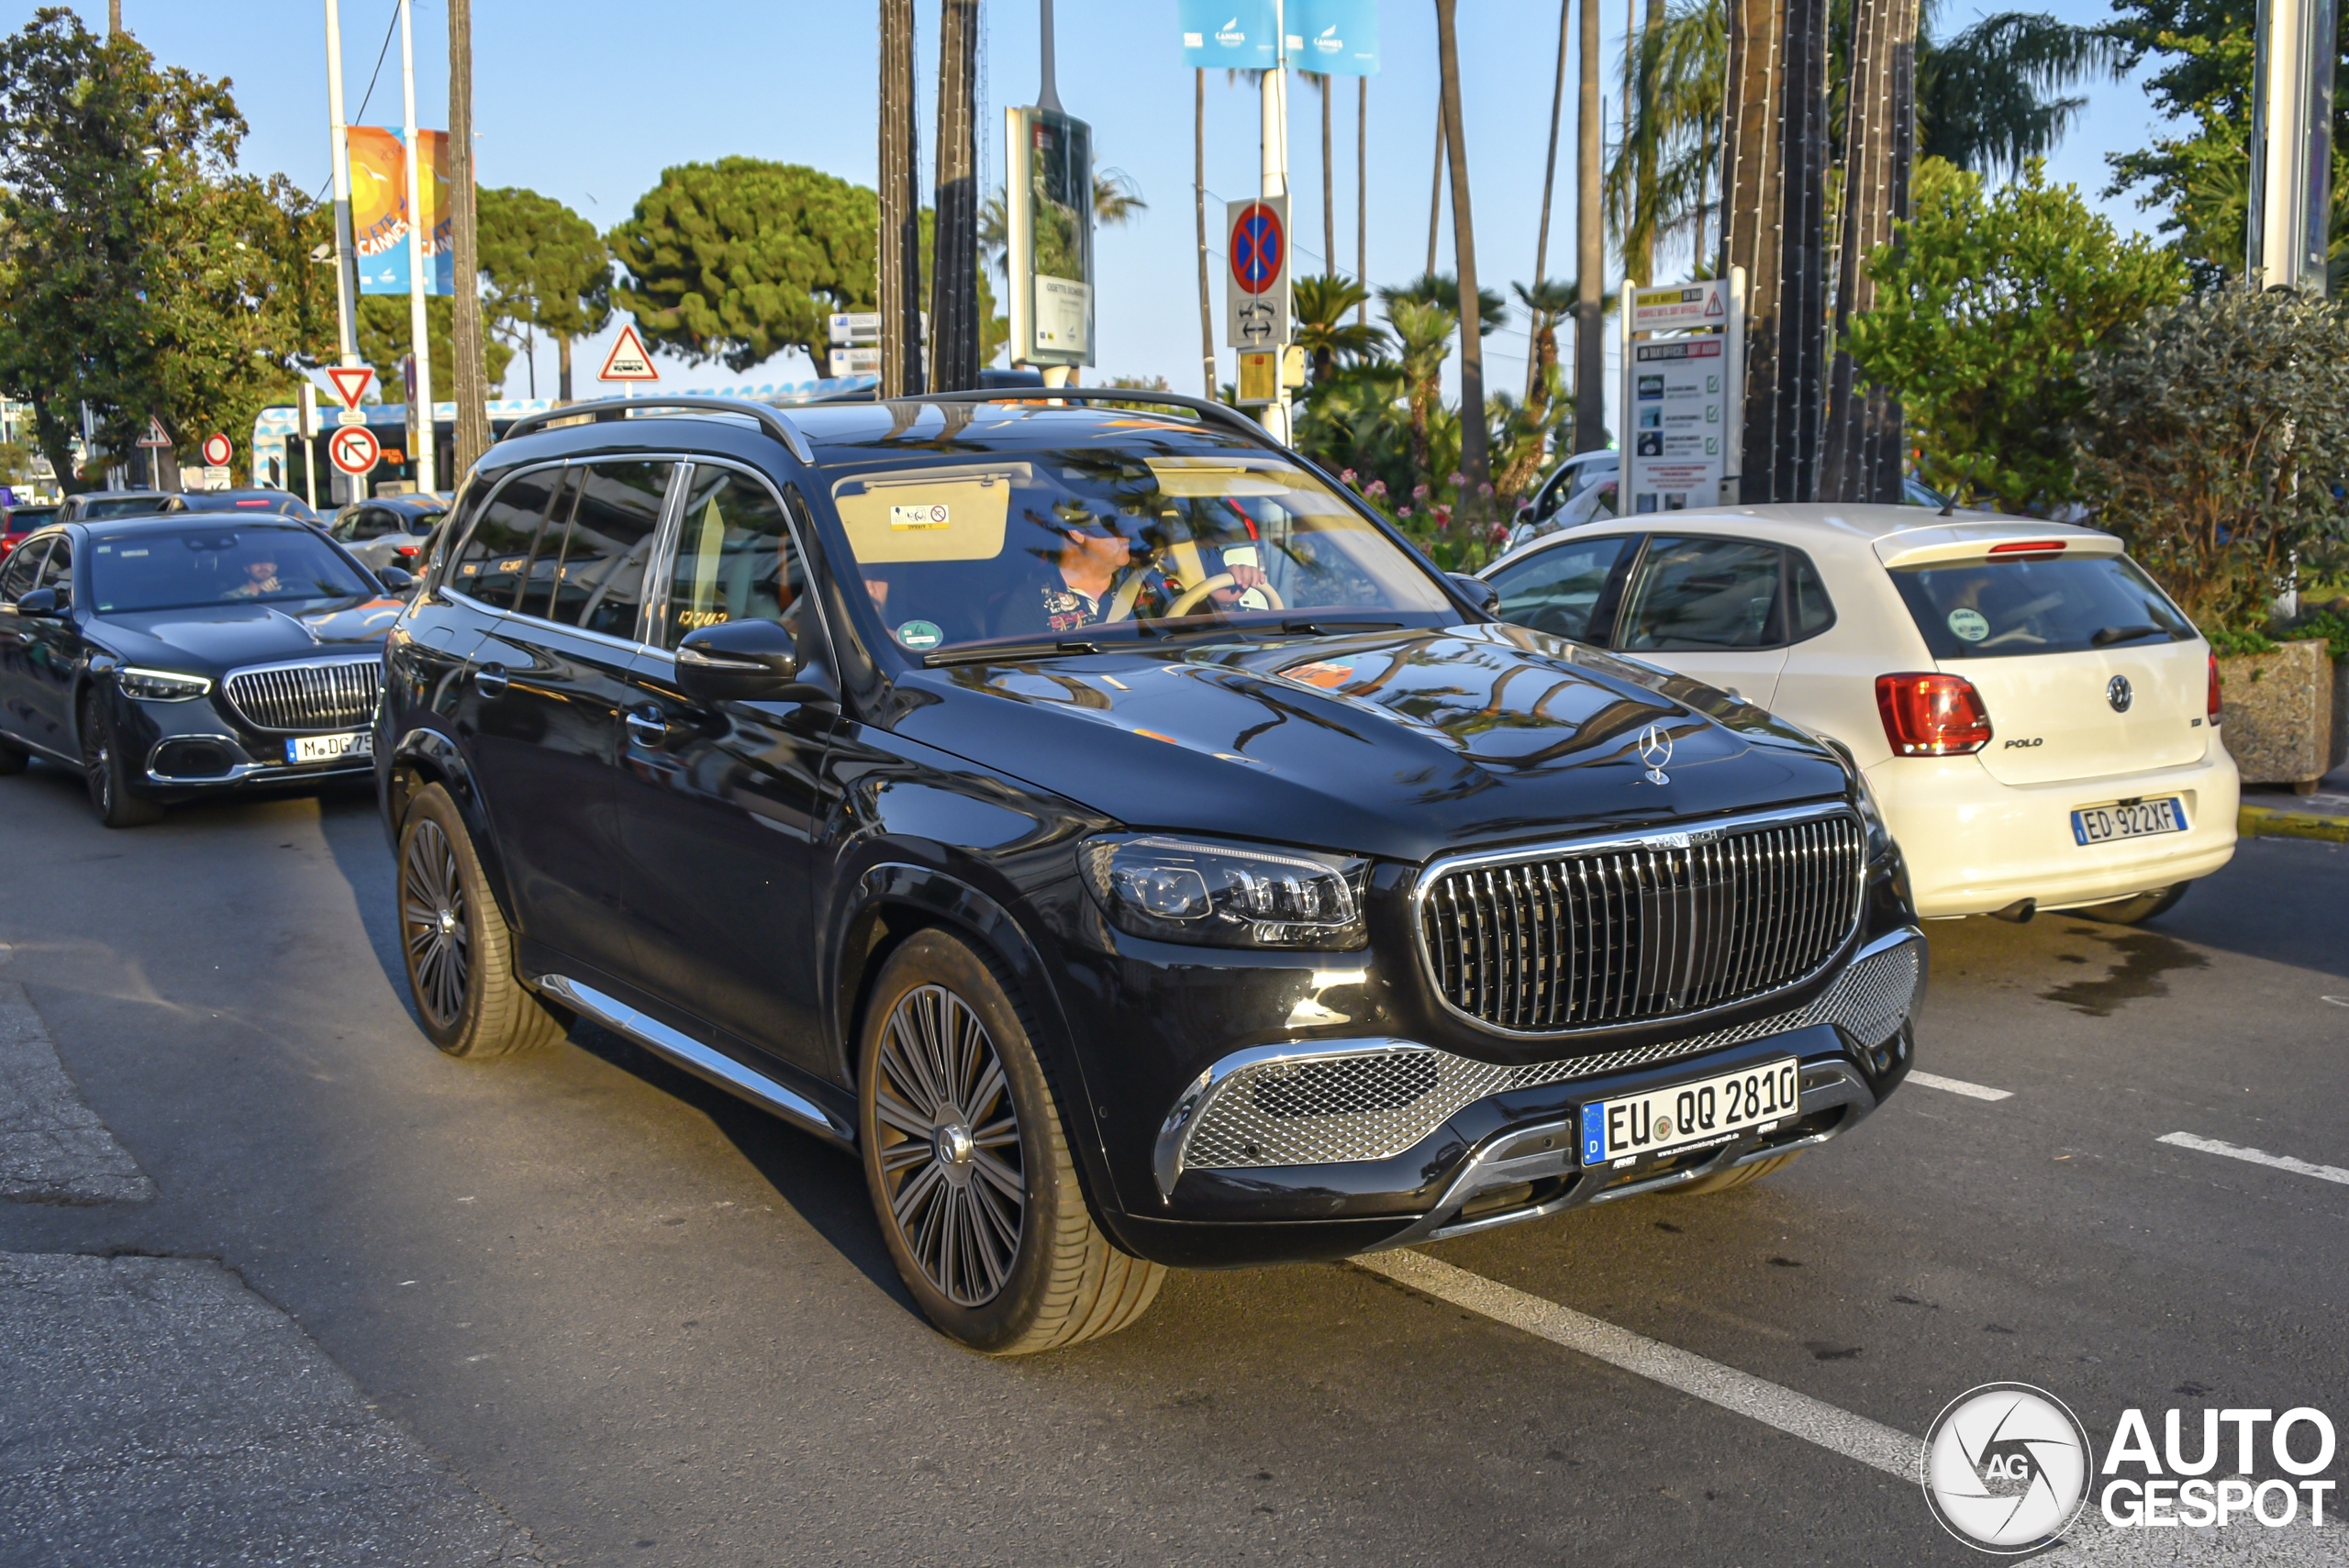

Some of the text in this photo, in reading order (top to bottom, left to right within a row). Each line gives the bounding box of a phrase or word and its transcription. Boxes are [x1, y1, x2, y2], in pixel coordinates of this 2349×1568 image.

[1215, 31, 1245, 41] CANNES
[1313, 38, 1343, 48] CANNES
[358, 217, 410, 257] CANNES
[1640, 348, 1649, 359] UN
[1650, 346, 1663, 358] TAXI
[1663, 344, 1687, 357] OFFICIEL
[914, 625, 925, 635] 4
[2004, 738, 2043, 749] POLO
[2084, 810, 2111, 840] ED
[2116, 802, 2172, 834] 922XF
[1655, 829, 1718, 848] MAYBACH
[1589, 1066, 1795, 1153] D EU QQ 2810
[1756, 1120, 1778, 1134] ARNDT
[1657, 1132, 1740, 1157] www.autovermietung-arndt.de
[1612, 1155, 1637, 1170] ARNDT
